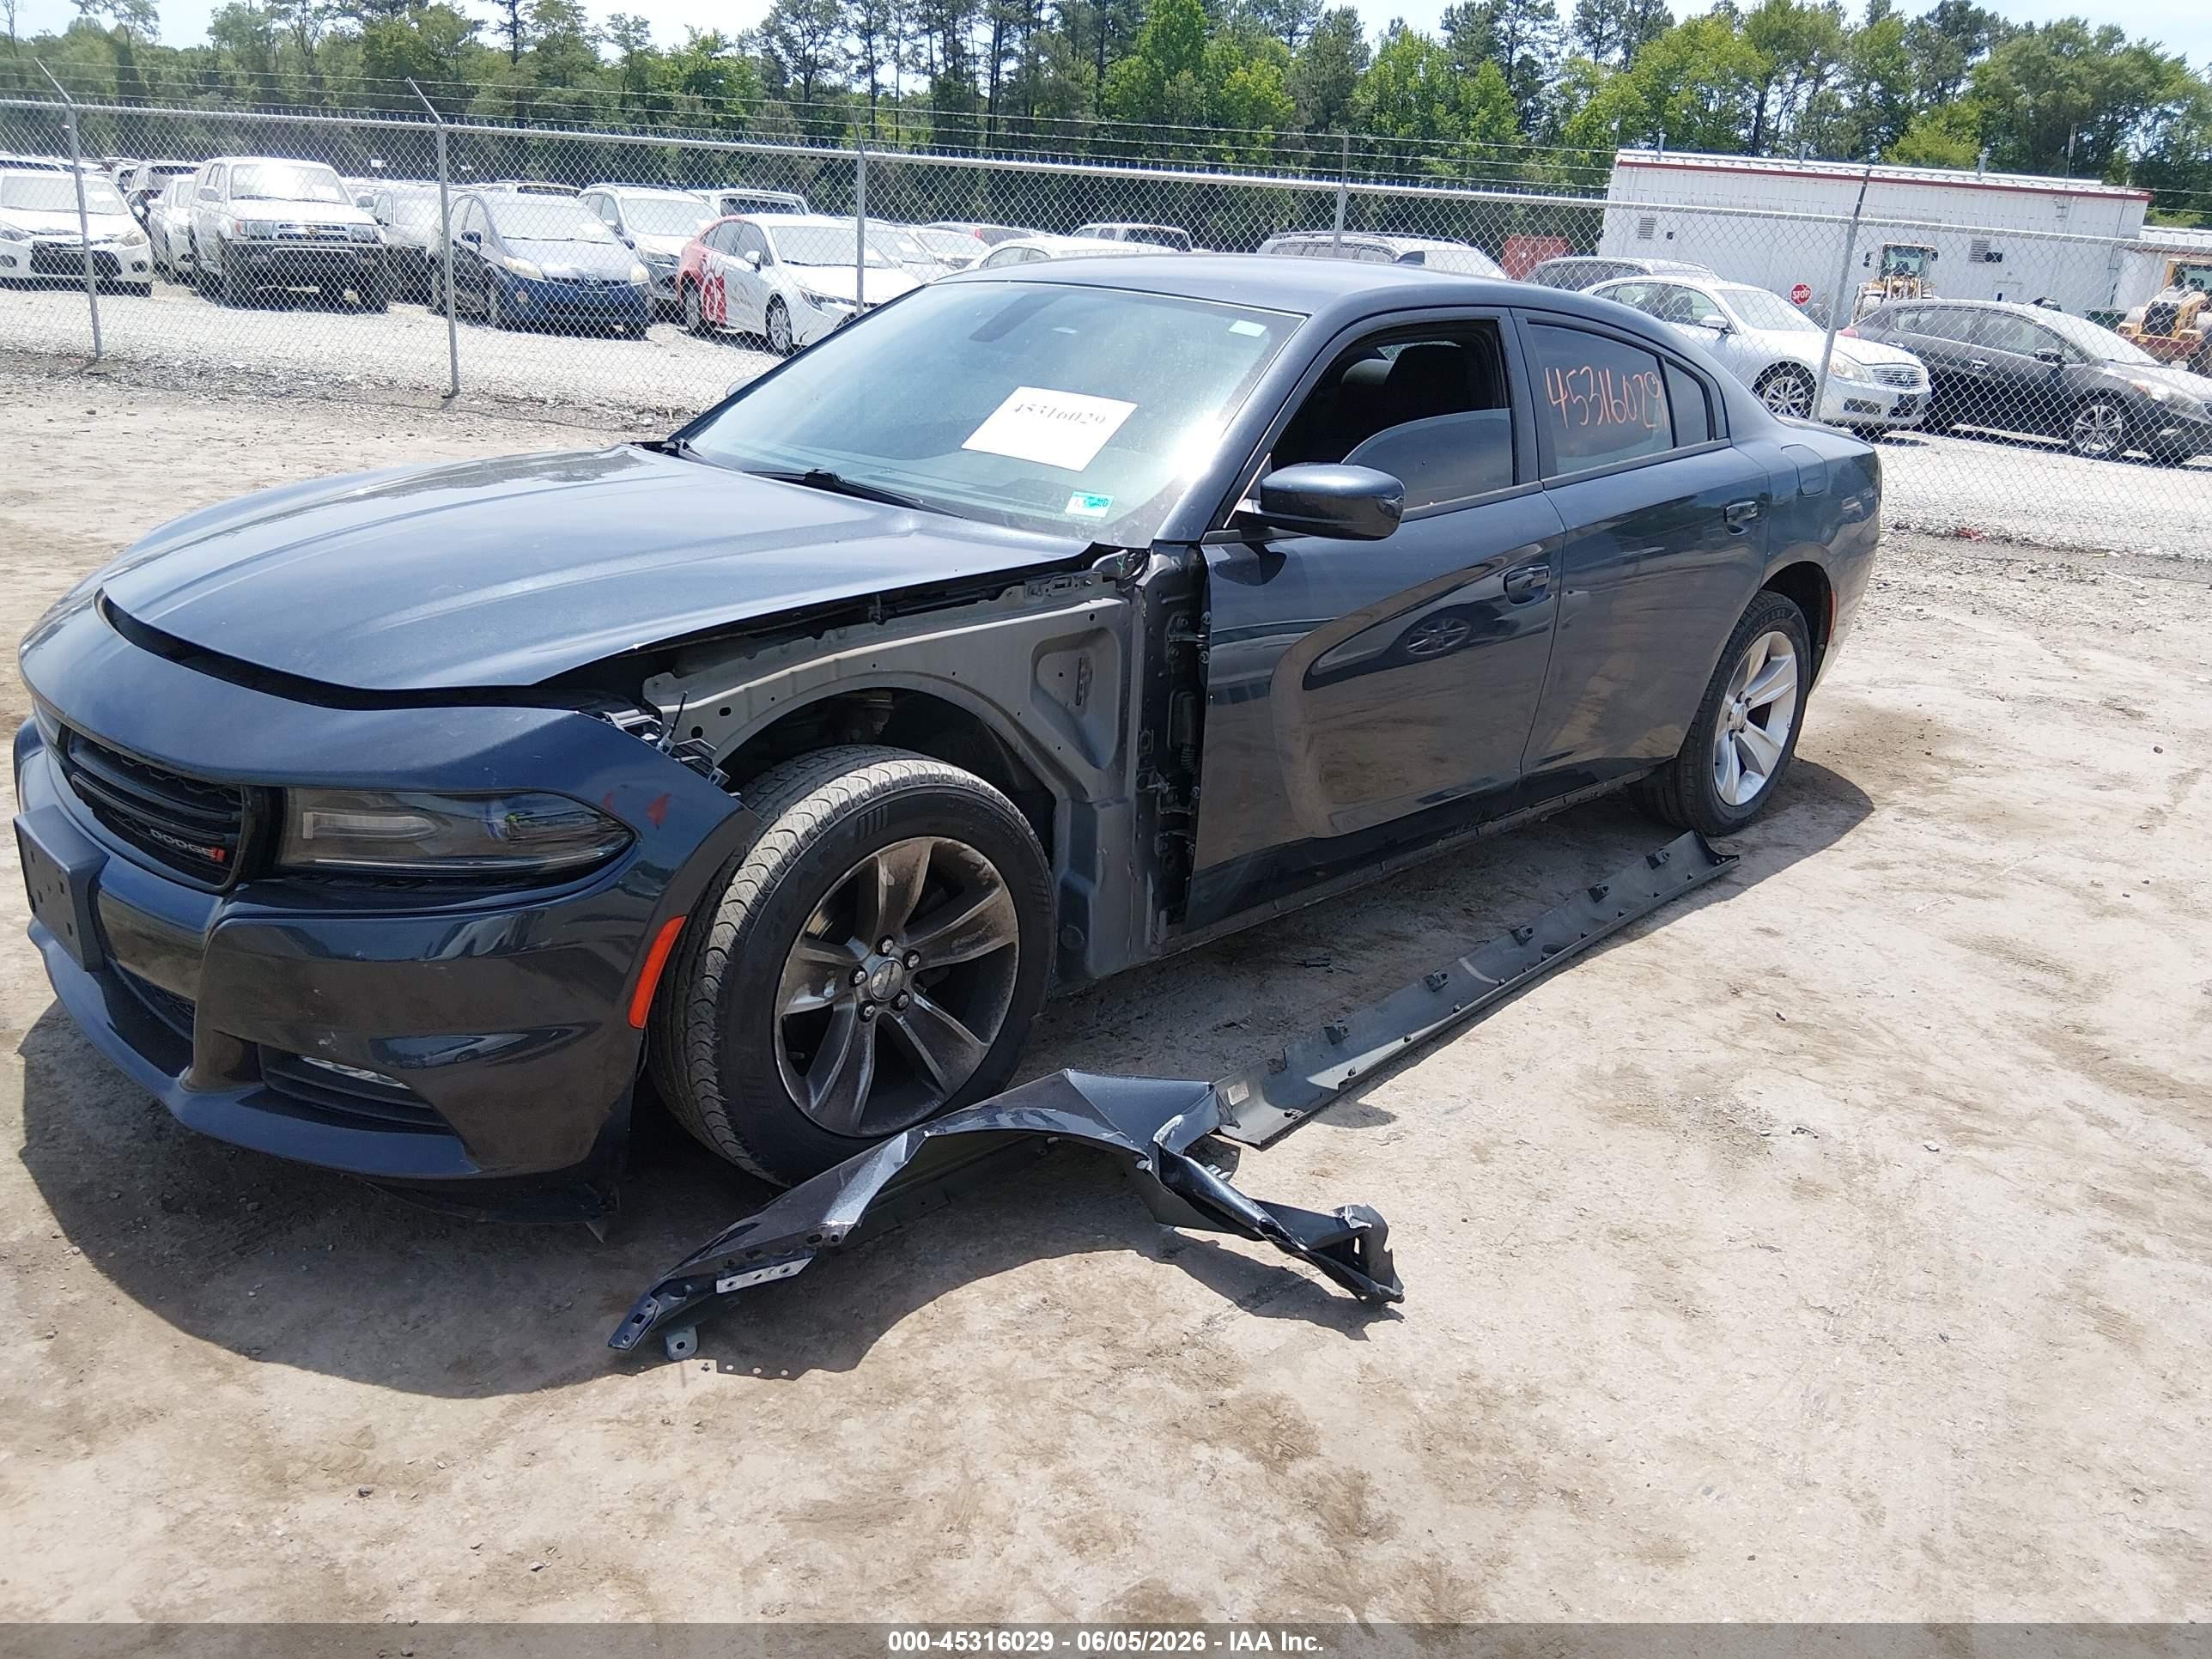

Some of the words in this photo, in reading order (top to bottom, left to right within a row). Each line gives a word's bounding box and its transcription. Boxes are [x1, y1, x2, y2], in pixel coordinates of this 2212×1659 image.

[1792, 289, 1810, 300] STOP
[1545, 366, 1668, 428] 45316029
[149, 829, 216, 860] DODGE
